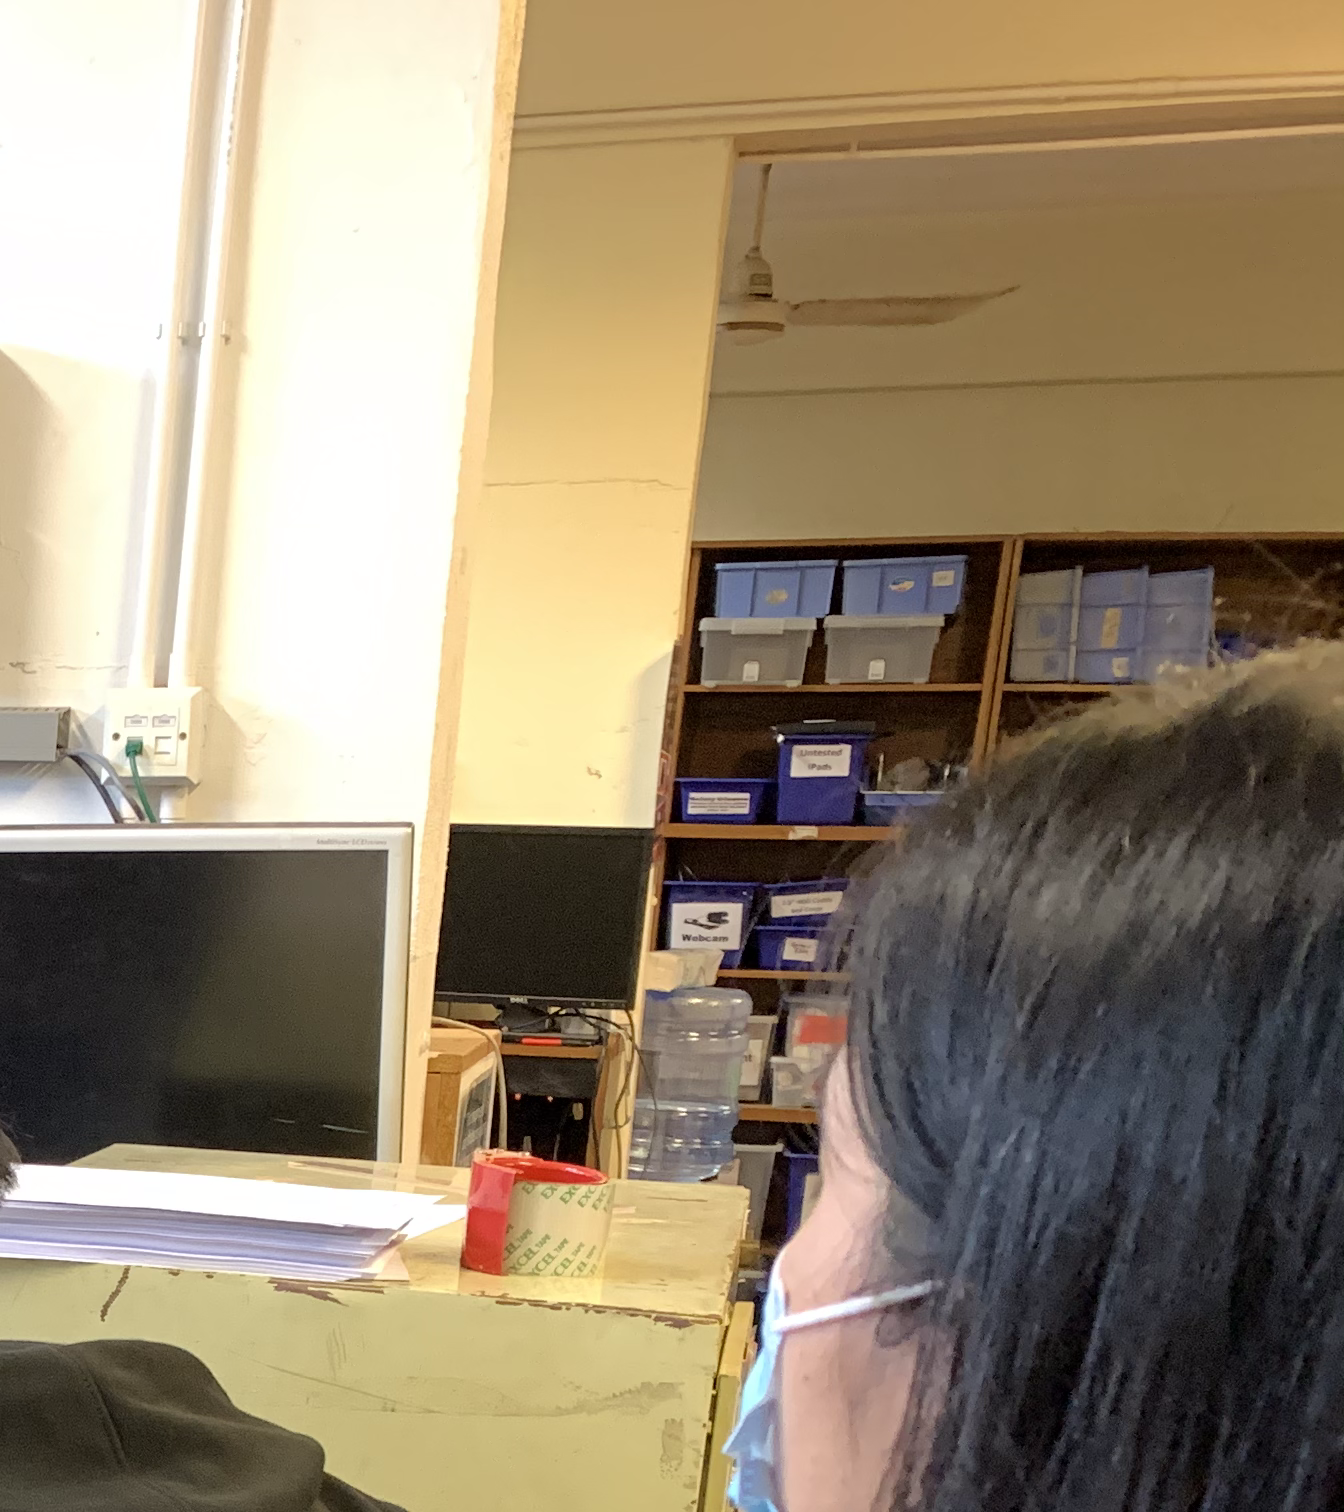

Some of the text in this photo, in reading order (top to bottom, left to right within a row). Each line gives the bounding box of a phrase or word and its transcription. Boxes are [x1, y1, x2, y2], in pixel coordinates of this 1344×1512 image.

[799, 748, 843, 757] Untested
[681, 933, 729, 943] Webcam
[535, 1233, 552, 1249] TAPE
[554, 1238, 569, 1254] TAPE
